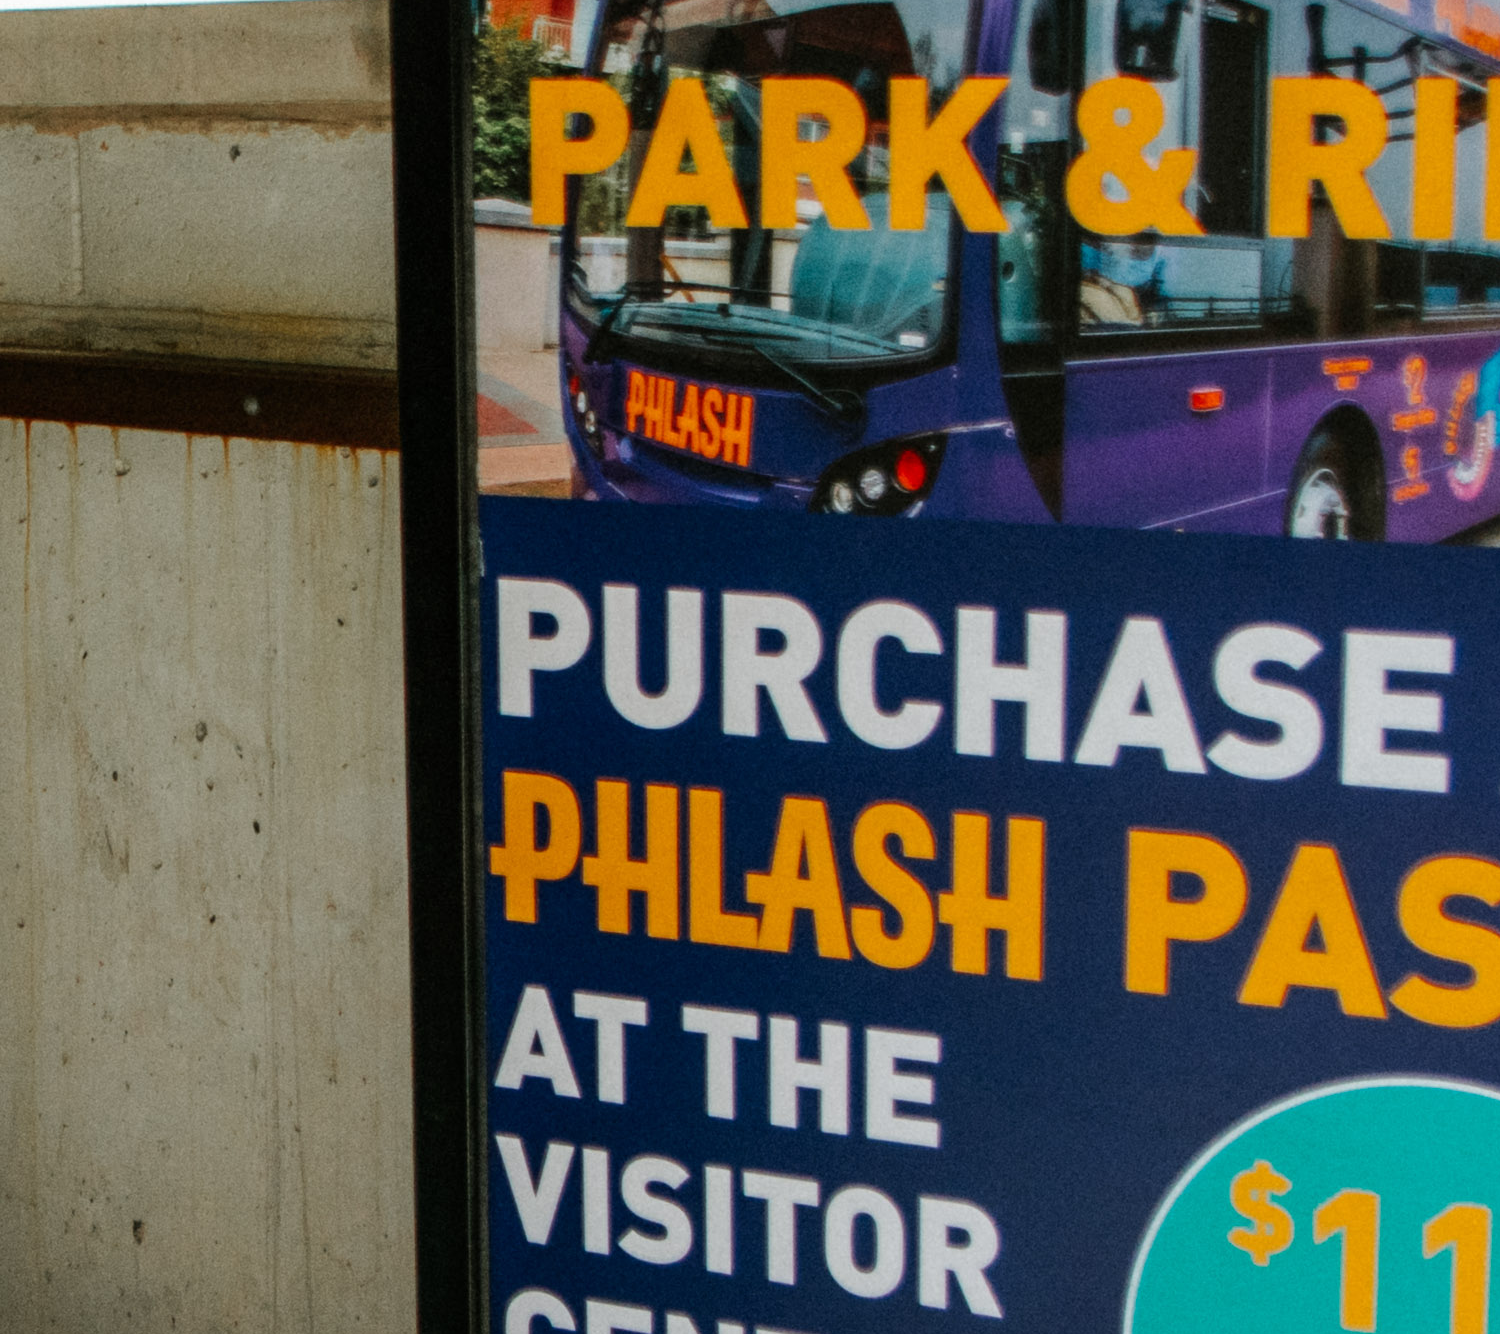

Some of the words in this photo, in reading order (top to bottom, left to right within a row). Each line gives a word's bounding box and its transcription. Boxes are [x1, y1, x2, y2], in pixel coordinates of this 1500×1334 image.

[528, 75, 1013, 233] PARK
[1065, 75, 1209, 239] &
[625, 368, 755, 468] PHLASH
[495, 576, 1457, 797] PURCHASE
[489, 768, 1047, 985] PHLASH
[493, 981, 649, 1106] AT
[681, 1000, 944, 1151] THE
[493, 1130, 1005, 1322] VISITOR
